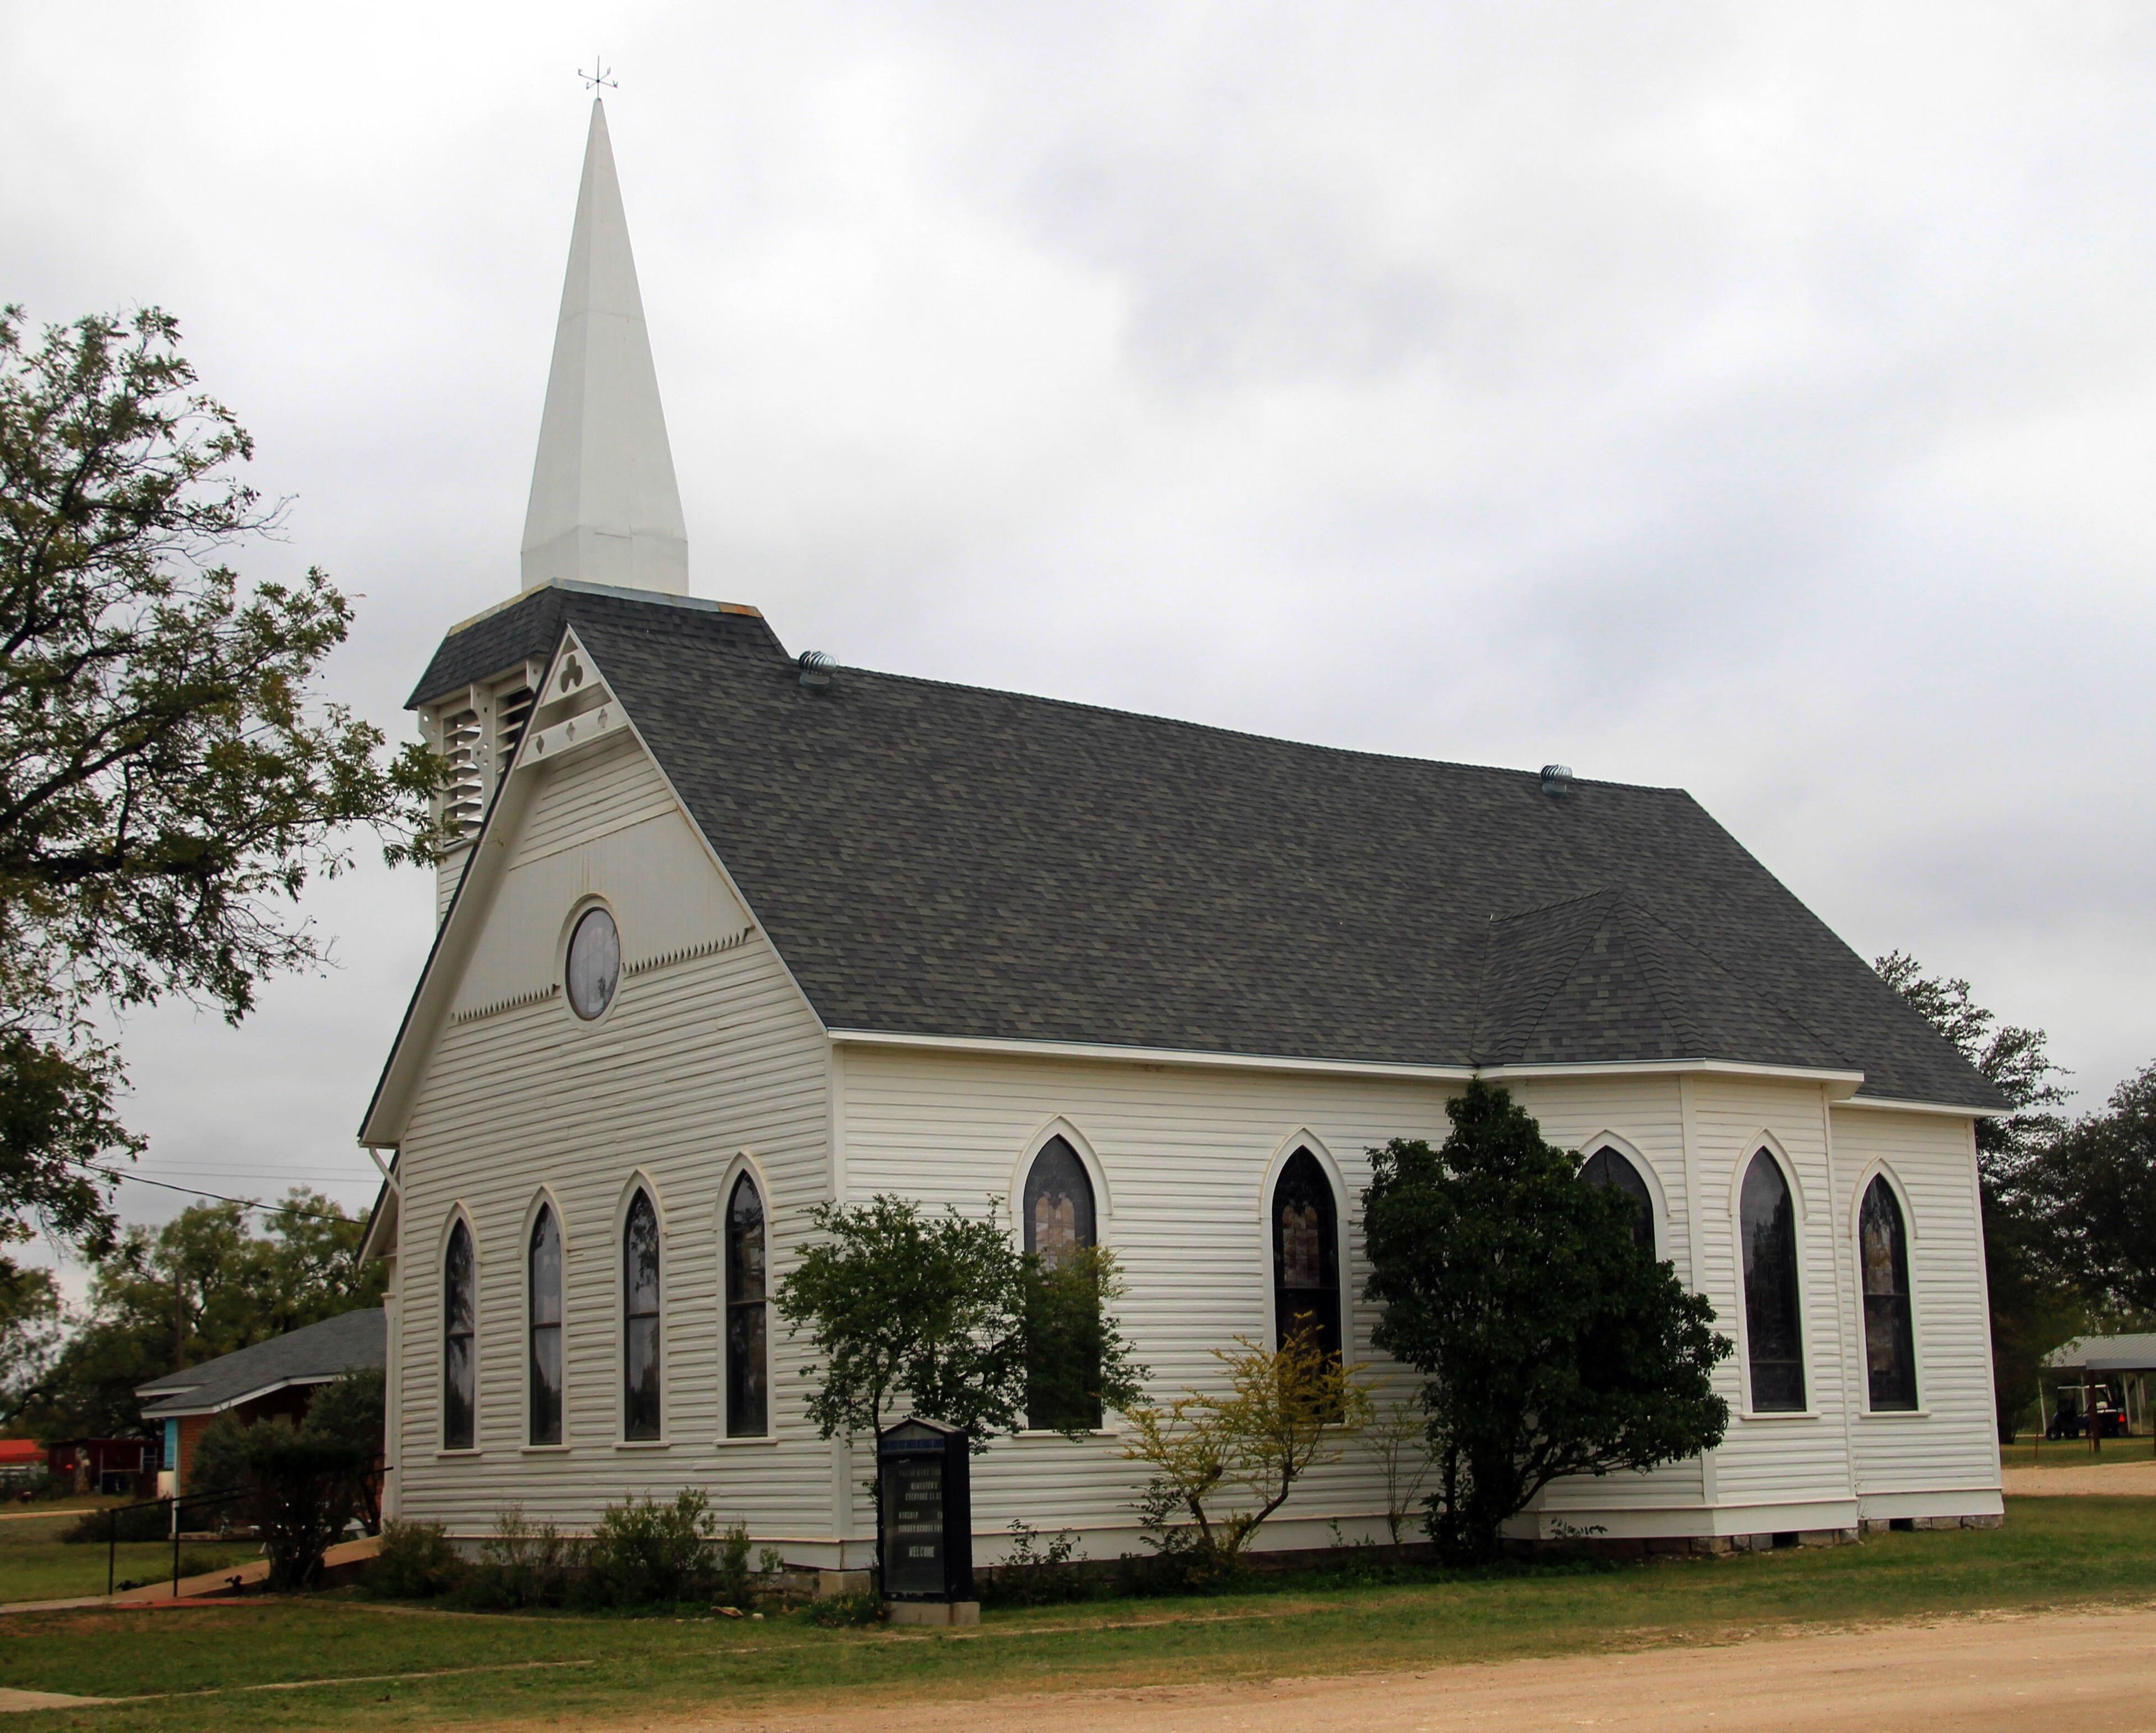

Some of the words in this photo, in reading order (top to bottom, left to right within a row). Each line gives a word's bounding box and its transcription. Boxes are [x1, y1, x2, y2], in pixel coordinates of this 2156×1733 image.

[905, 1492, 928, 1500] EVERYONE
[898, 1524, 916, 1533] SUNDAY
[916, 1524, 933, 1533] SCHOOL
[908, 1545, 934, 1557] WELCOME
